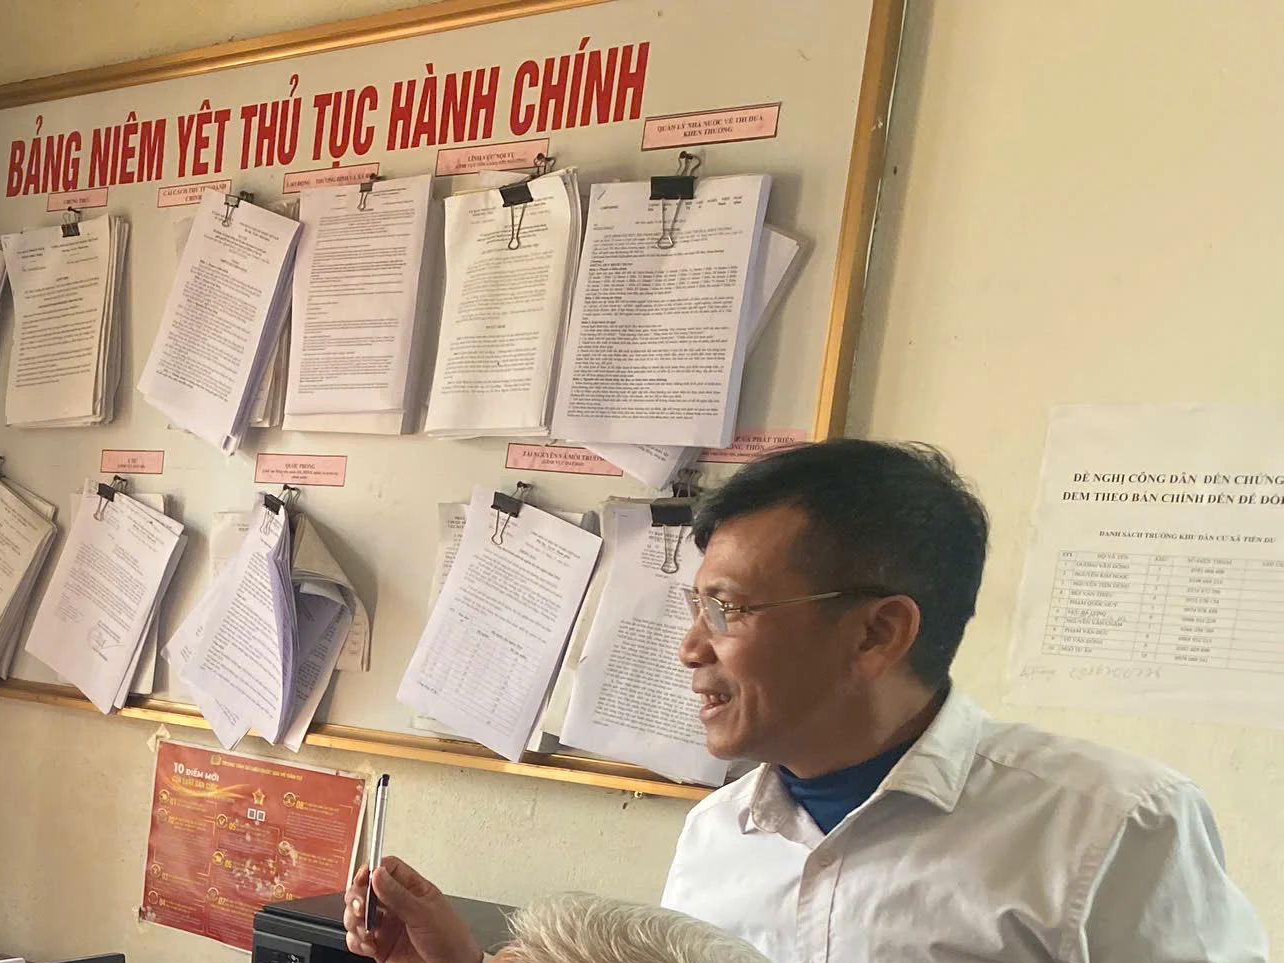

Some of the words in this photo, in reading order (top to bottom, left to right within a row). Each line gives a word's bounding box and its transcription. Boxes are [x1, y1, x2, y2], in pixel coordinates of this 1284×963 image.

[6, 115, 81, 197] BẢNG
[88, 111, 166, 188] NIÊM
[240, 74, 302, 169] THỦ
[312, 84, 378, 168] TỤC
[387, 63, 501, 151] HÀNH
[510, 36, 650, 136] CHÍNH
[683, 129, 702, 138] KHEN
[1093, 473, 1125, 485] NGHỊ
[1128, 471, 1166, 483] CÔNG
[1169, 472, 1197, 484] DÂN
[1094, 492, 1129, 502] THEO
[173, 762, 185, 774] 10
